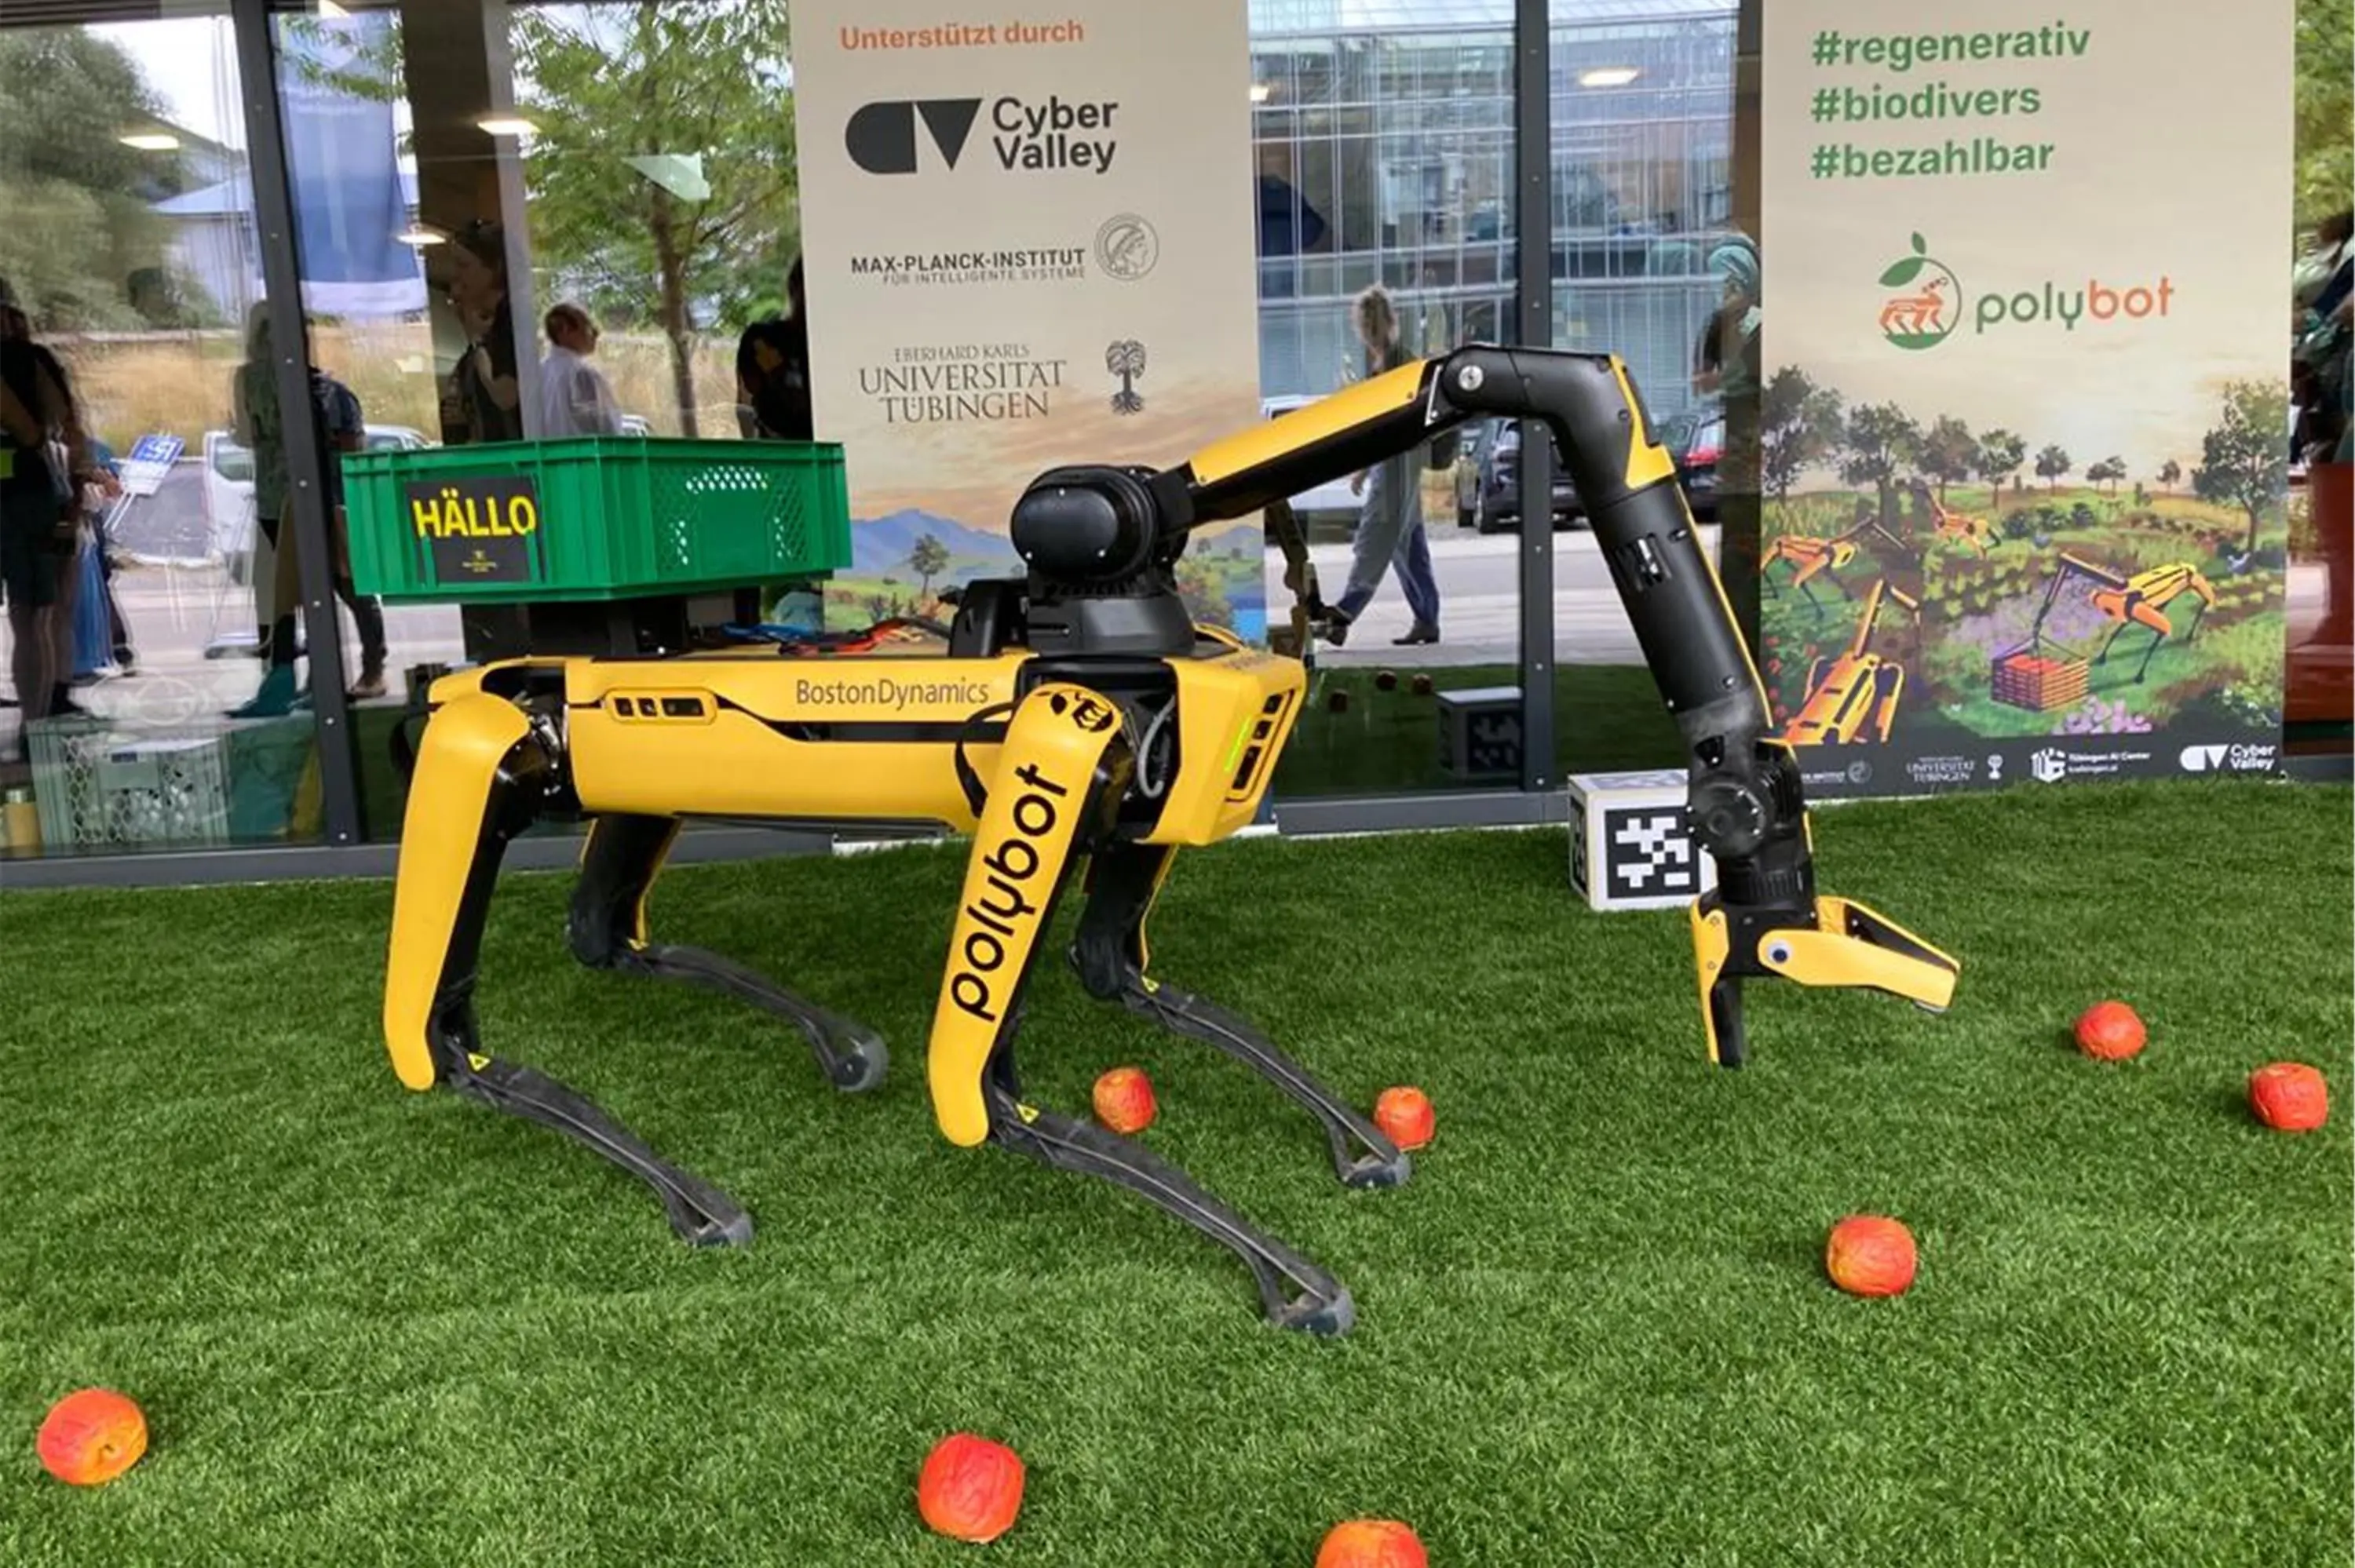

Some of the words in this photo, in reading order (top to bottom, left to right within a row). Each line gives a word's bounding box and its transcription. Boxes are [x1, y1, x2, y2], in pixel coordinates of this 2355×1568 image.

[841, 23, 996, 50] Unterstützt
[1004, 20, 1084, 44] durch
[1813, 20, 2090, 71] #regenerativ
[992, 95, 1119, 140] Cyber
[1811, 82, 2041, 123] #biodivers
[992, 133, 1116, 174] Valley
[1811, 137, 2054, 179] #bezahlbar
[851, 248, 1086, 274] MAX-PLANCK-INSTITUT
[915, 269, 1016, 284] INTELLIGENTE
[1022, 265, 1085, 281] SYSTEME
[1976, 277, 2174, 334] polybot
[860, 360, 1067, 395] UNIVERSITÄT
[879, 391, 1049, 423] TÜBINGEN
[412, 487, 537, 538] HÄLLO
[2229, 757, 2275, 771] Valley
[2230, 743, 2276, 758] Cyber
[951, 763, 1068, 1021] polybot
